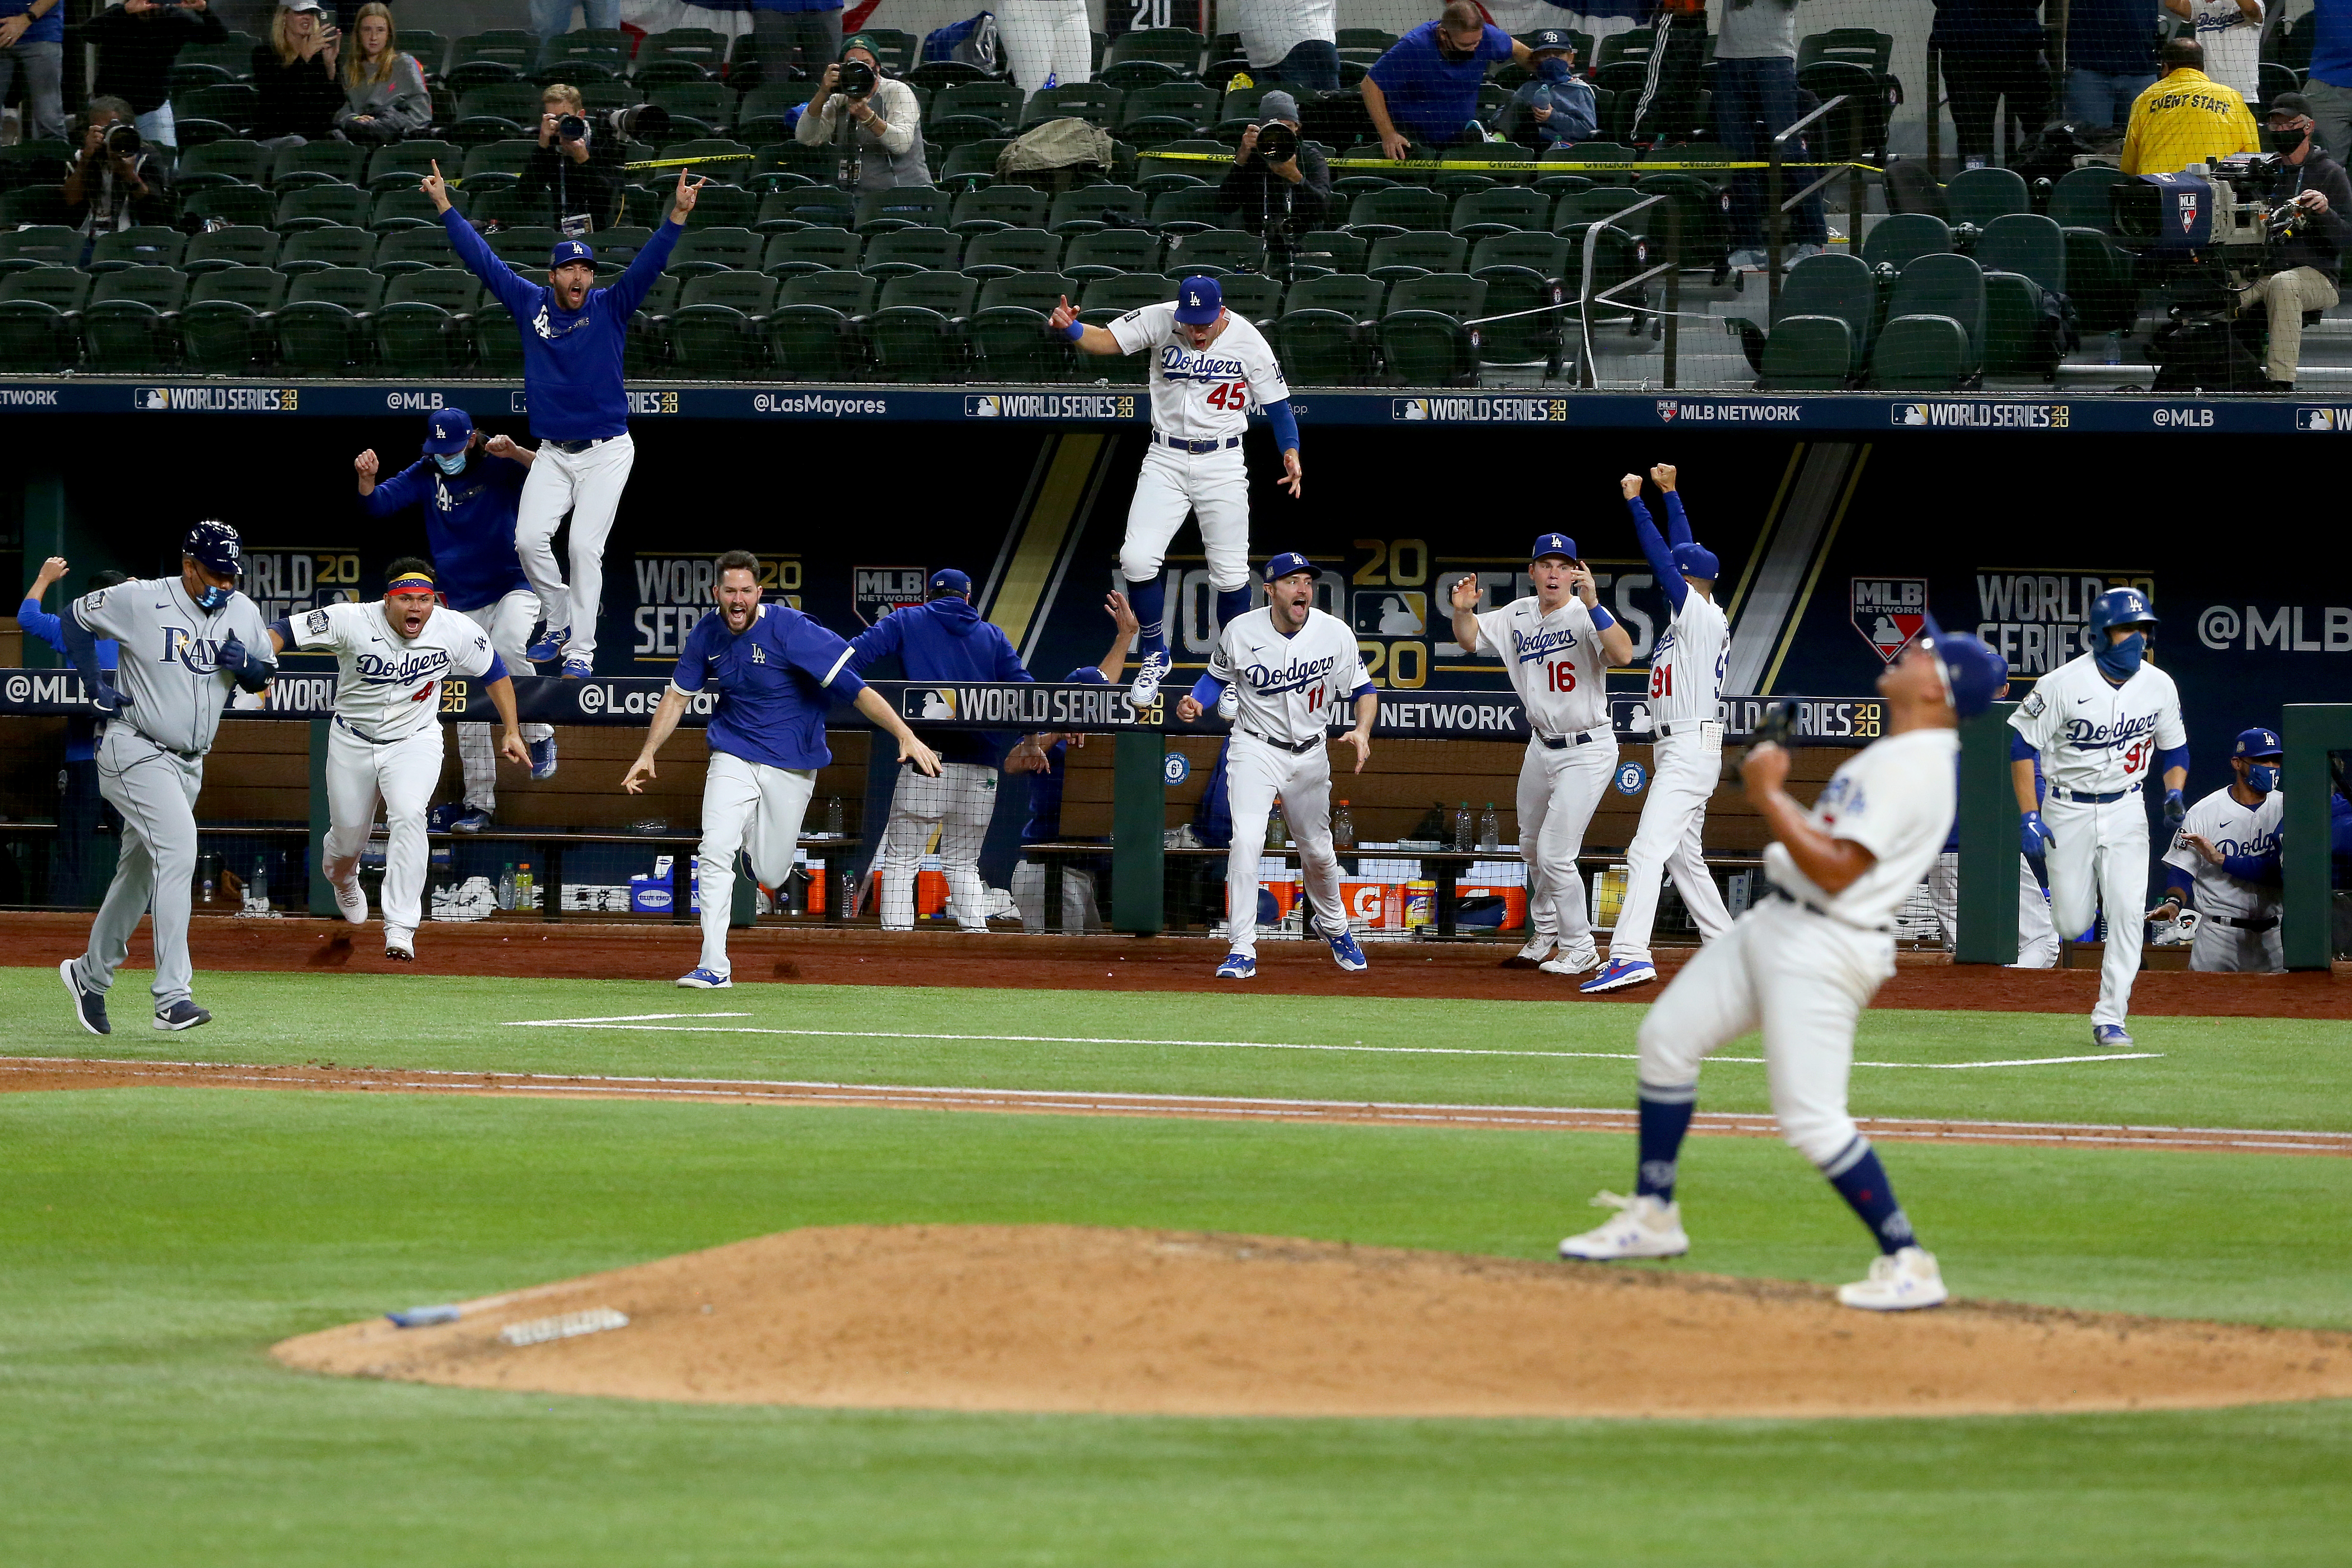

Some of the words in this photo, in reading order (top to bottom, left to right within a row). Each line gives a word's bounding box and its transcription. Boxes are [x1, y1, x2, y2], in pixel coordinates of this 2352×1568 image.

[1131, 0, 1170, 30] 20
[1544, 31, 1558, 43] TB
[2150, 94, 2190, 112] EVENT
[2191, 94, 2230, 115] STAFF
[2180, 196, 2195, 206] MLB
[571, 242, 583, 254] LA
[1190, 291, 1201, 306] LA
[532, 304, 551, 339] LA
[1161, 345, 1242, 384] Dodgers
[0, 390, 58, 405] TWORK
[170, 388, 225, 410] WORLD
[228, 389, 280, 410] SERIES
[281, 389, 298, 400] 20
[387, 392, 444, 409] @MLB
[625, 392, 660, 413] RIES
[661, 392, 678, 402] 20
[1117, 396, 1133, 406] 20
[1207, 382, 1246, 410] 45
[281, 400, 298, 411] 20
[661, 403, 678, 413] 20
[754, 394, 887, 417] @LasMayores
[1002, 395, 1060, 417] WORLD
[1062, 396, 1116, 418] SERIES
[1117, 407, 1133, 418] 20
[1430, 399, 1490, 421] WORLD
[1493, 399, 1548, 421] SERIES
[1549, 400, 1566, 411] 20
[1549, 411, 1566, 421] 20
[1680, 405, 1715, 420] MLB
[1717, 406, 1801, 420] NETWORK
[1930, 403, 1990, 426] WORLD
[1993, 405, 2050, 427] SERIES
[2051, 406, 2069, 417] 20
[2051, 417, 2069, 428] 20
[2153, 409, 2214, 427] @MLB
[436, 425, 446, 438] LA
[225, 541, 239, 558] TB
[1551, 535, 1562, 548] LA
[317, 555, 360, 583] 20
[1292, 552, 1304, 565] LA
[1352, 539, 1427, 586] 20
[235, 554, 313, 598] ORLD
[635, 560, 719, 604] WOR
[758, 561, 802, 589] 20
[858, 572, 923, 594] MLB
[858, 594, 923, 603] NETWORK
[1856, 582, 1923, 606] MLB
[2128, 595, 2143, 612] LA
[316, 611, 327, 631] WORLD
[1856, 606, 1923, 615] NETWORK
[309, 613, 321, 633] SERIES
[634, 606, 716, 654] SER
[2198, 605, 2352, 652] @MLB
[158, 625, 233, 677] RAY
[474, 635, 487, 652] LA
[751, 643, 765, 664] LA
[1512, 628, 1577, 665] Dodgers
[355, 651, 449, 686] Dodgers
[1356, 641, 1427, 689] 20
[1245, 658, 1334, 697] Dodgers
[1547, 661, 1576, 692] 16
[1651, 664, 1672, 699] 91
[271, 679, 335, 712] WORL
[411, 681, 434, 703] 4
[443, 681, 467, 697] 20
[1308, 682, 1325, 714] 11
[441, 697, 466, 713] 20
[960, 688, 1045, 722] WORLD
[1053, 691, 1135, 725] SERIES
[1854, 704, 1880, 719] 20
[1139, 709, 1164, 725] 20
[1327, 702, 1356, 726] ML
[1380, 702, 1517, 730] NETWORK
[1715, 701, 1761, 735] RLD
[1854, 720, 1880, 737] 20
[2066, 712, 2160, 751] Dodgers
[2264, 732, 2275, 746] LA
[2123, 737, 2152, 774] 91
[432, 811, 441, 824] LA
[1353, 887, 1380, 920] G
